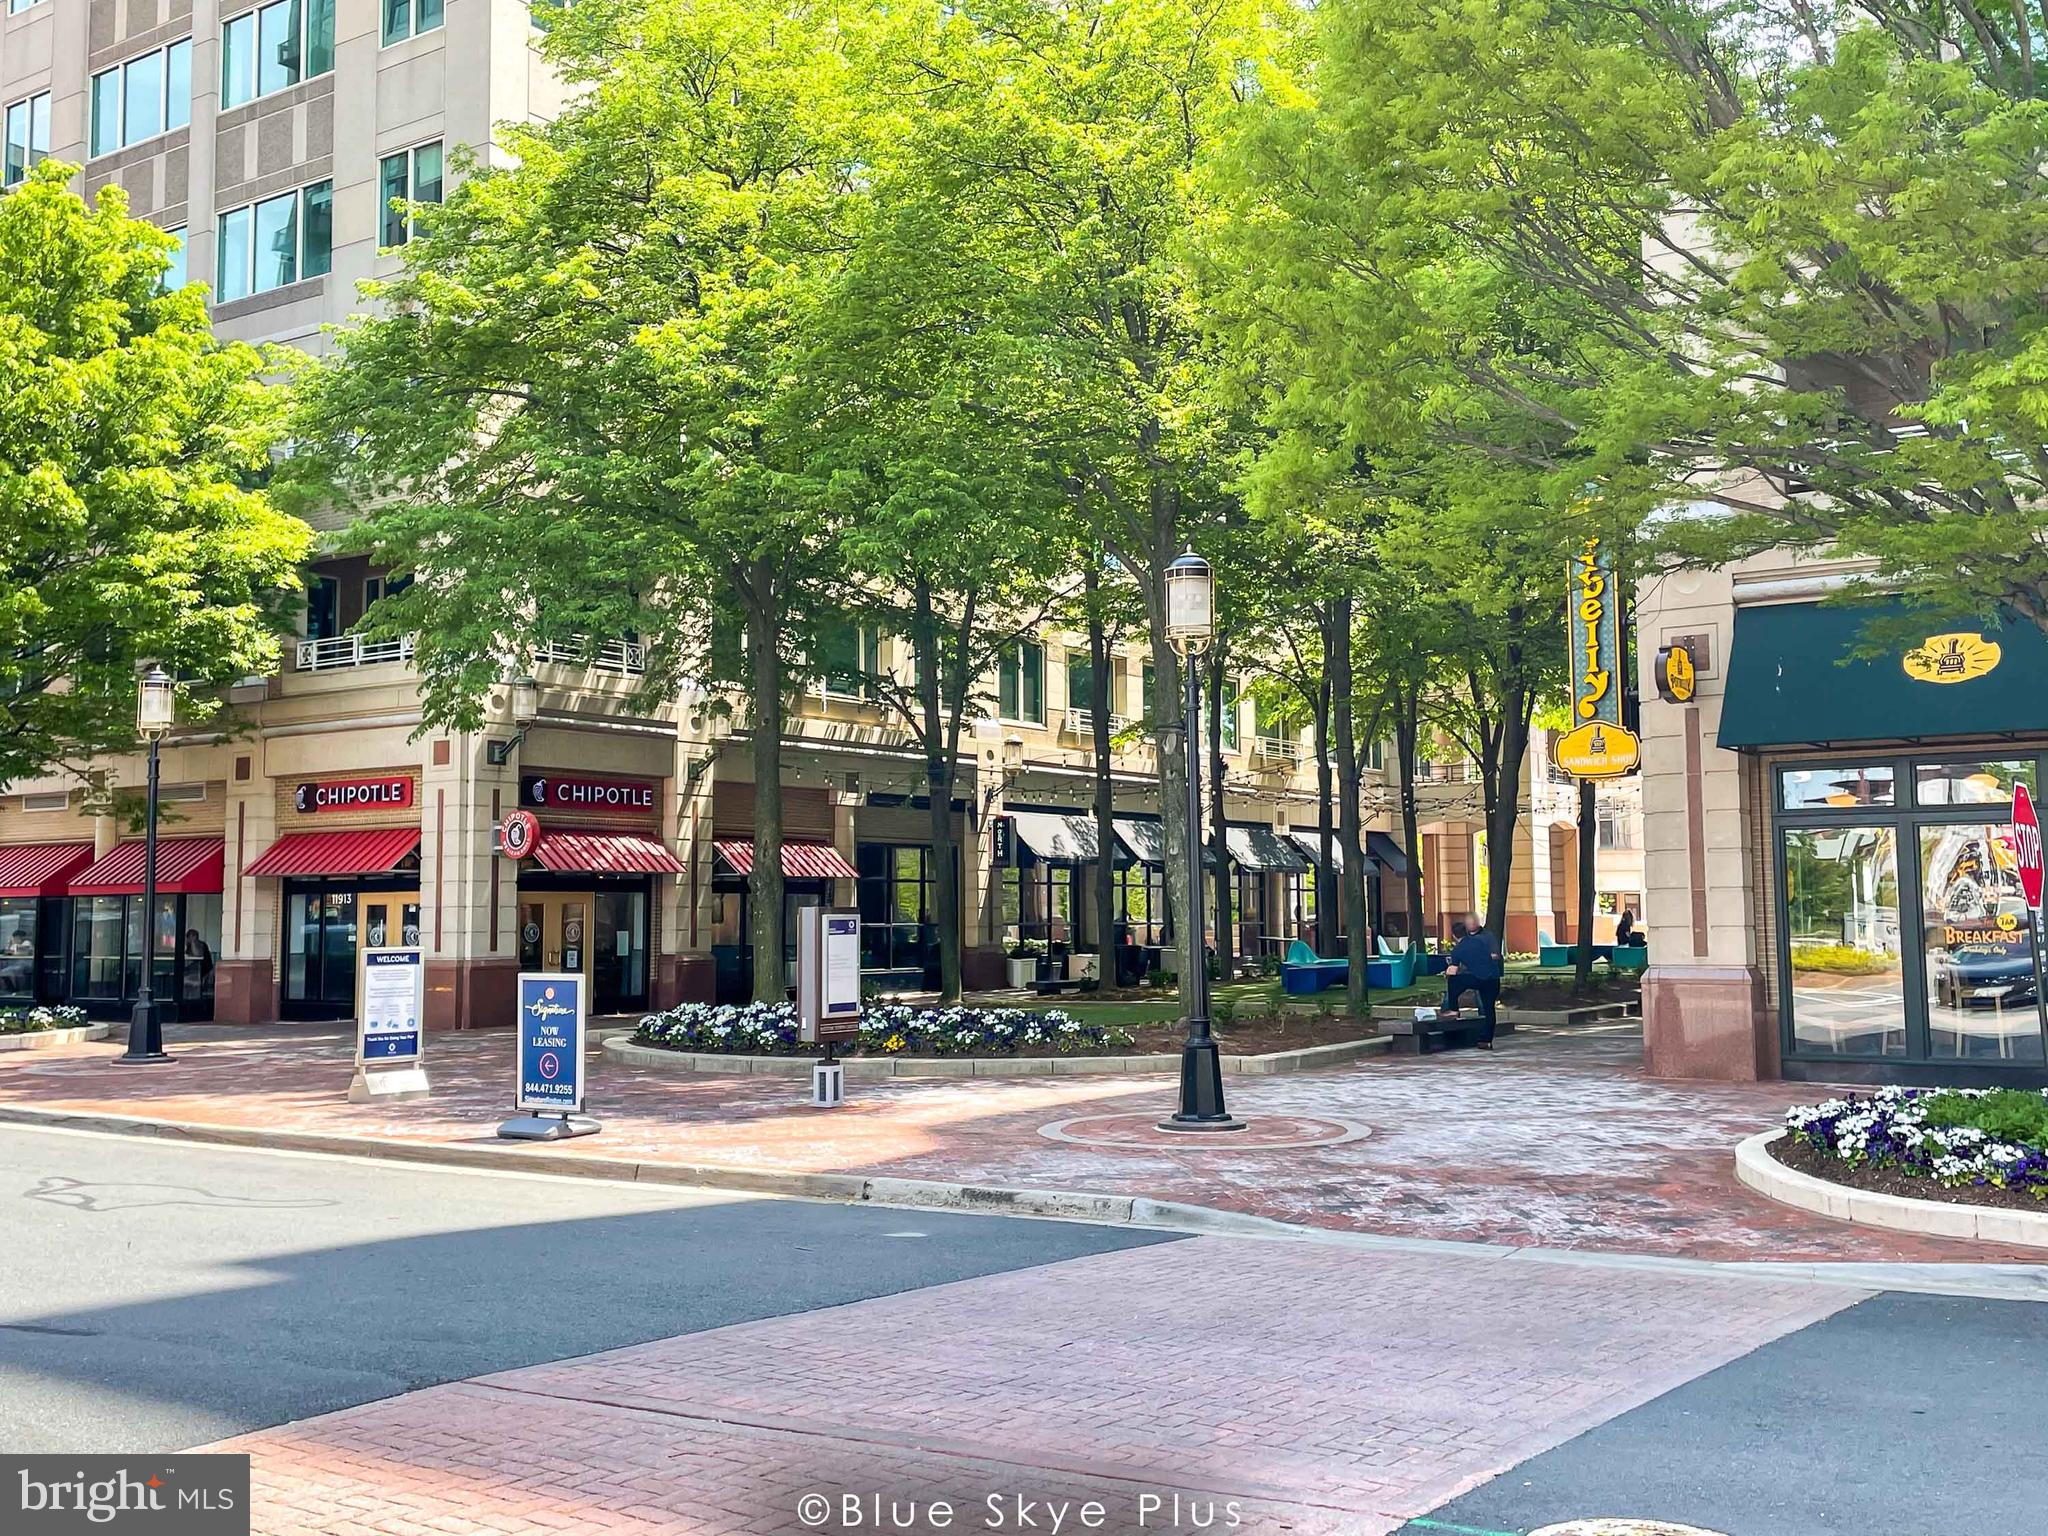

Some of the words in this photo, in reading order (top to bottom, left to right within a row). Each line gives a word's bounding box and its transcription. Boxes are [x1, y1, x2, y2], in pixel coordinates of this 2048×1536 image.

[1562, 756, 1608, 768] SANDWICH
[1611, 752, 1635, 765] SHOP
[316, 784, 401, 805] CHIPOTLE
[557, 784, 652, 806] CHIPOTLE
[501, 812, 531, 833] CHIPOTLE
[2014, 822, 2040, 869] STOP
[331, 893, 352, 904] 11913
[1944, 926, 2025, 944] BREAKFAST
[376, 955, 410, 963] WELCOME
[525, 998, 575, 1021] Signature
[540, 1026, 560, 1036] NOW
[532, 1037, 567, 1048] LEASING
[525, 1082, 573, 1095] 844.471.9255
